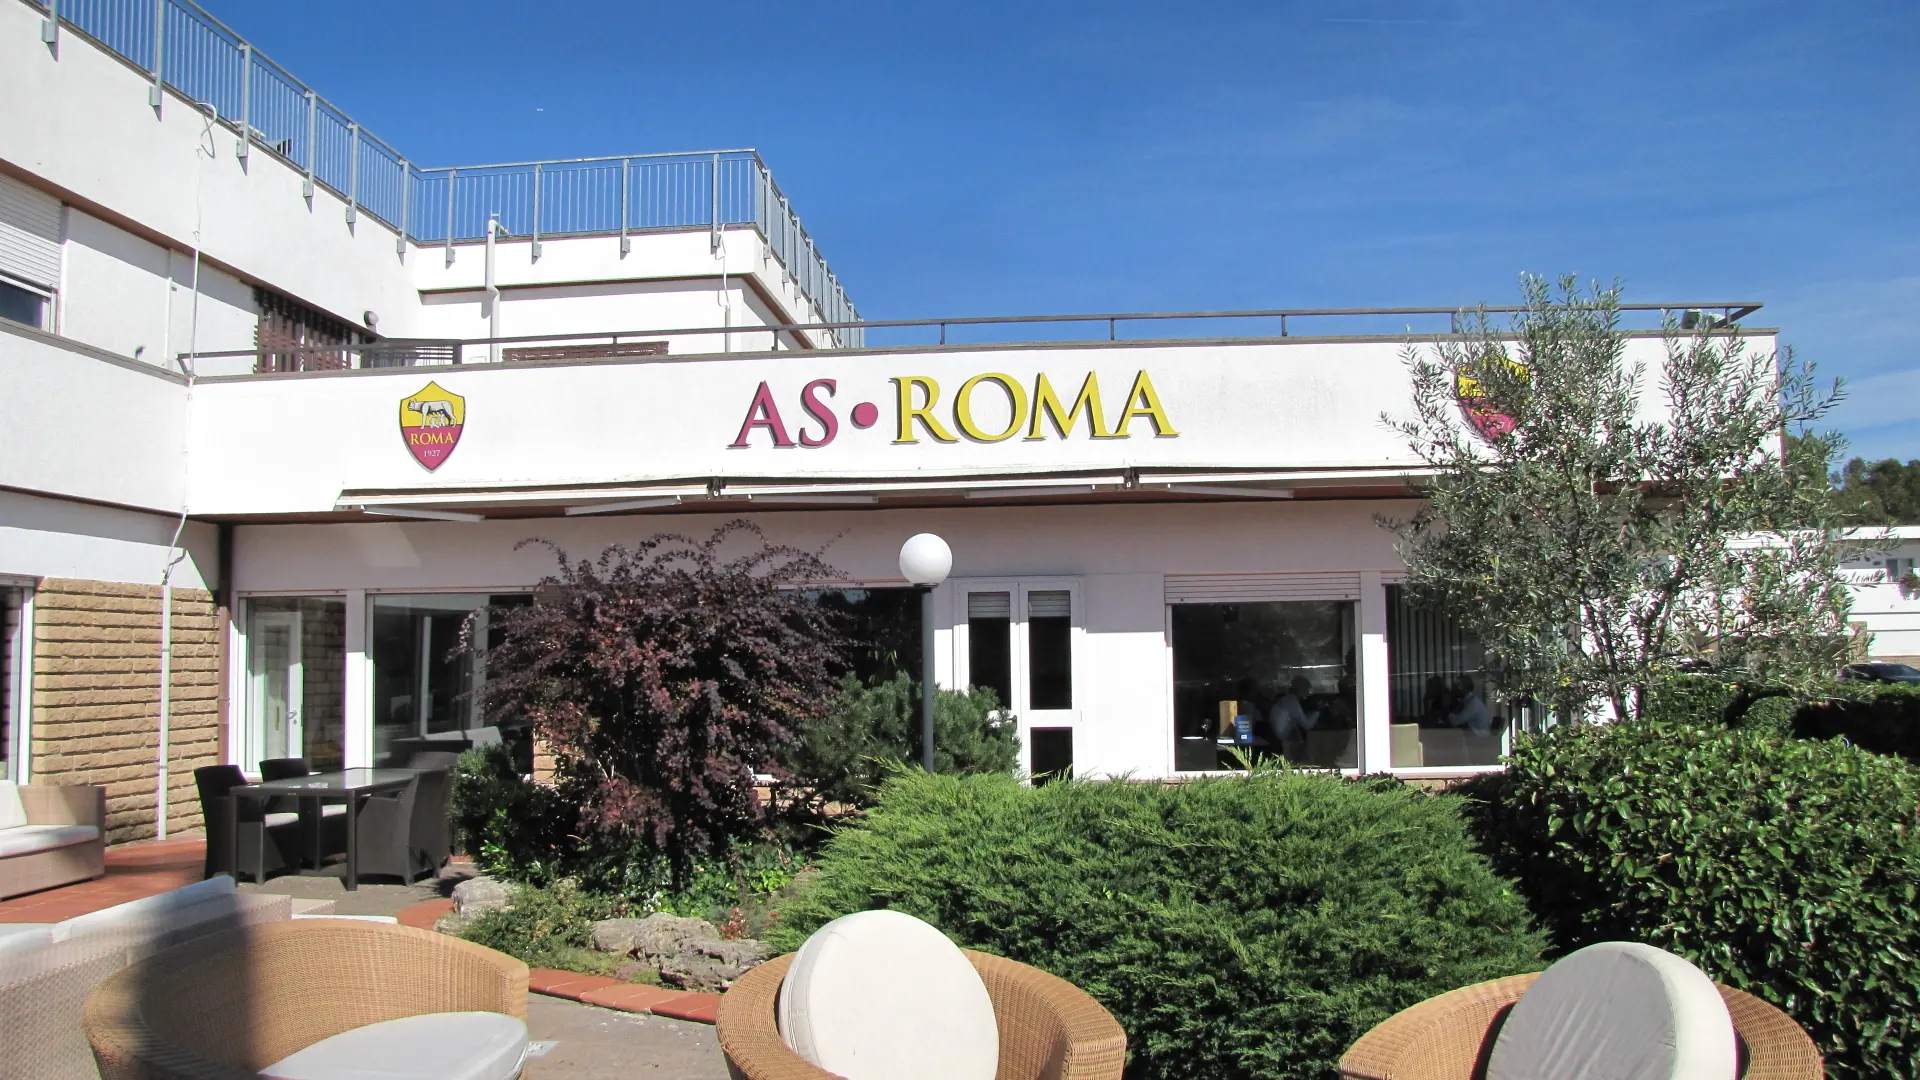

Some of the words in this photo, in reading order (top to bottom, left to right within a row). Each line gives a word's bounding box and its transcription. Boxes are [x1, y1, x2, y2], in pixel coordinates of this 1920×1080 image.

[727, 378, 839, 448] AS
[889, 368, 1179, 445] ROMA
[410, 432, 454, 445] ROMA
